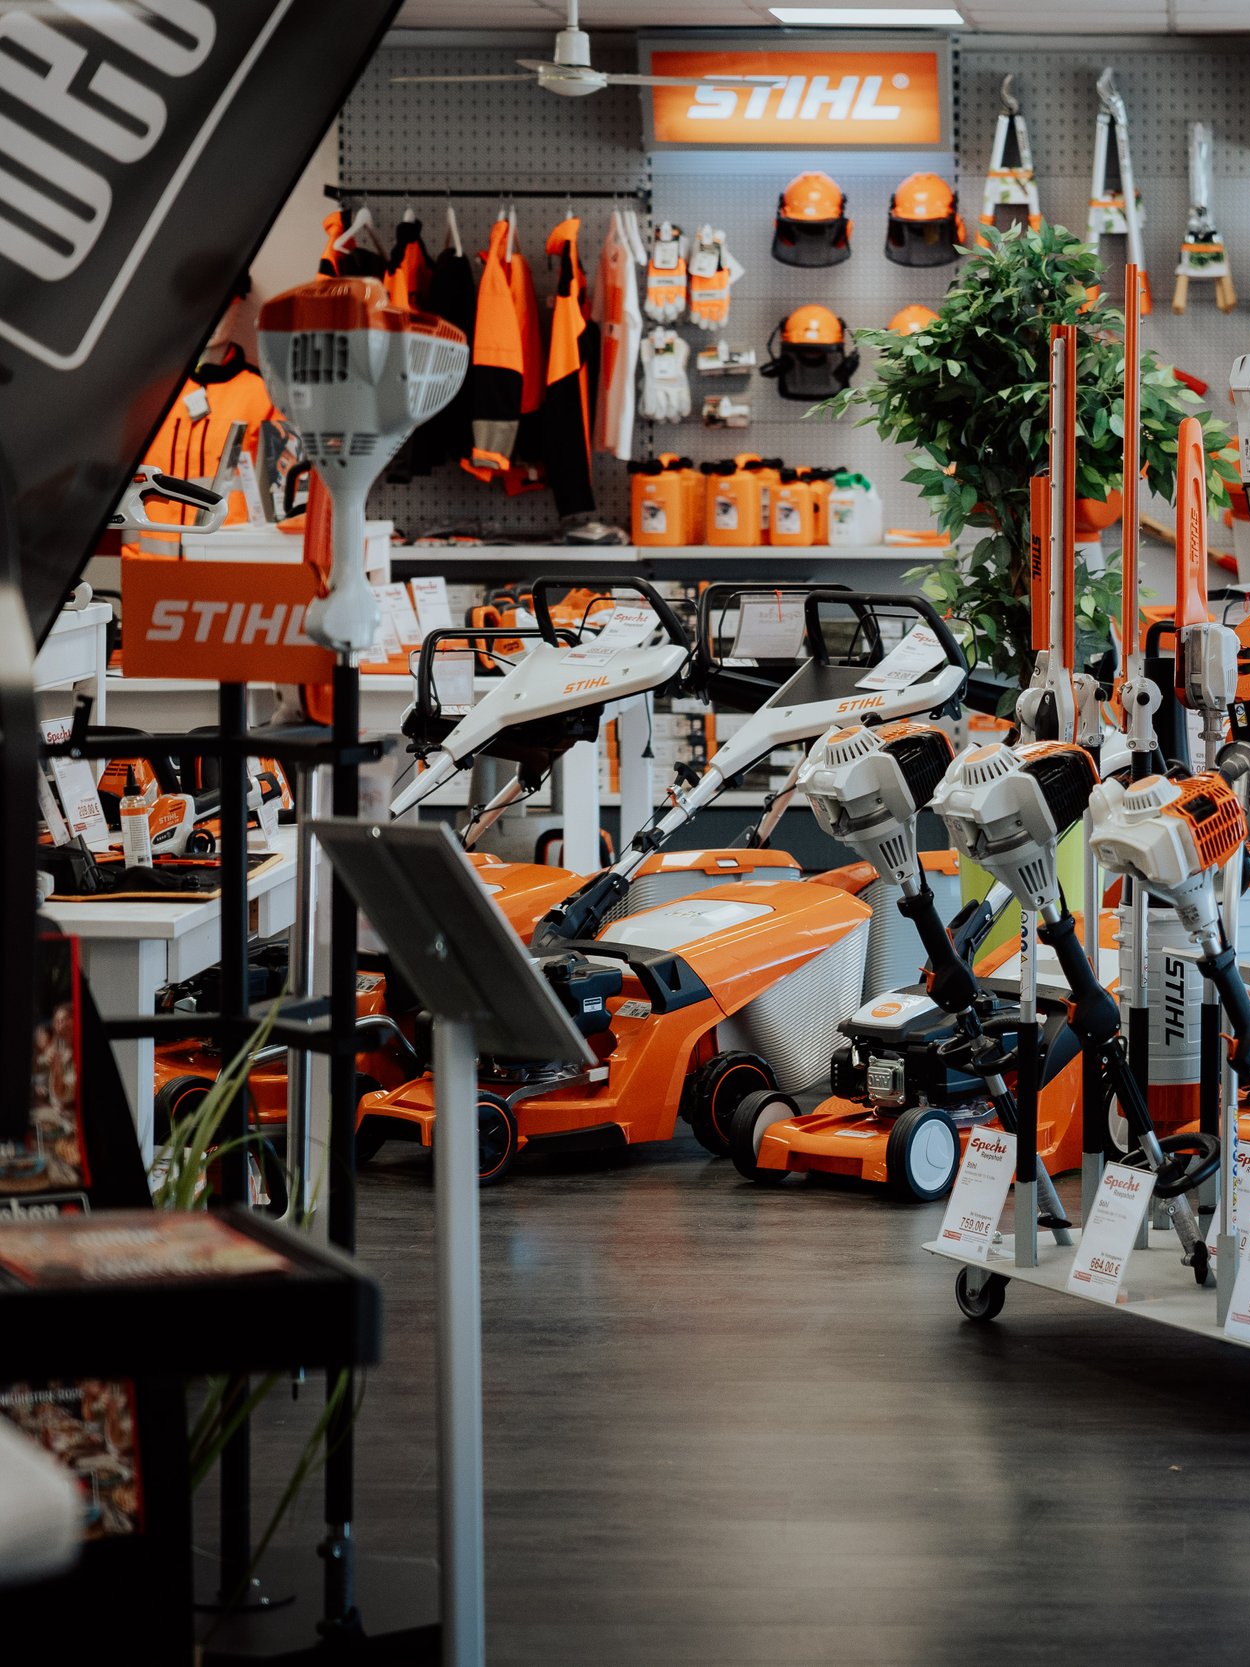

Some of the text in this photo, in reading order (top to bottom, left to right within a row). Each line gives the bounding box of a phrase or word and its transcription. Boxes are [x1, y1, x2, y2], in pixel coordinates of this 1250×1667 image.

[687, 74, 901, 120] STIHL
[1190, 507, 1201, 563] STIHL
[1032, 534, 1042, 580] STIHL
[146, 600, 316, 646] STIHL
[563, 676, 610, 696] STIHL
[836, 696, 886, 713] STIHL
[159, 812, 180, 824] STIHL
[1166, 957, 1184, 1046] STIHL
[970, 1137, 1007, 1154] Specht
[1103, 1174, 1140, 1192] Specht
[960, 1216, 984, 1232] 759,00
[984, 1223, 991, 1234] €
[1090, 1257, 1114, 1273] 664,00
[1114, 1263, 1121, 1275] €
